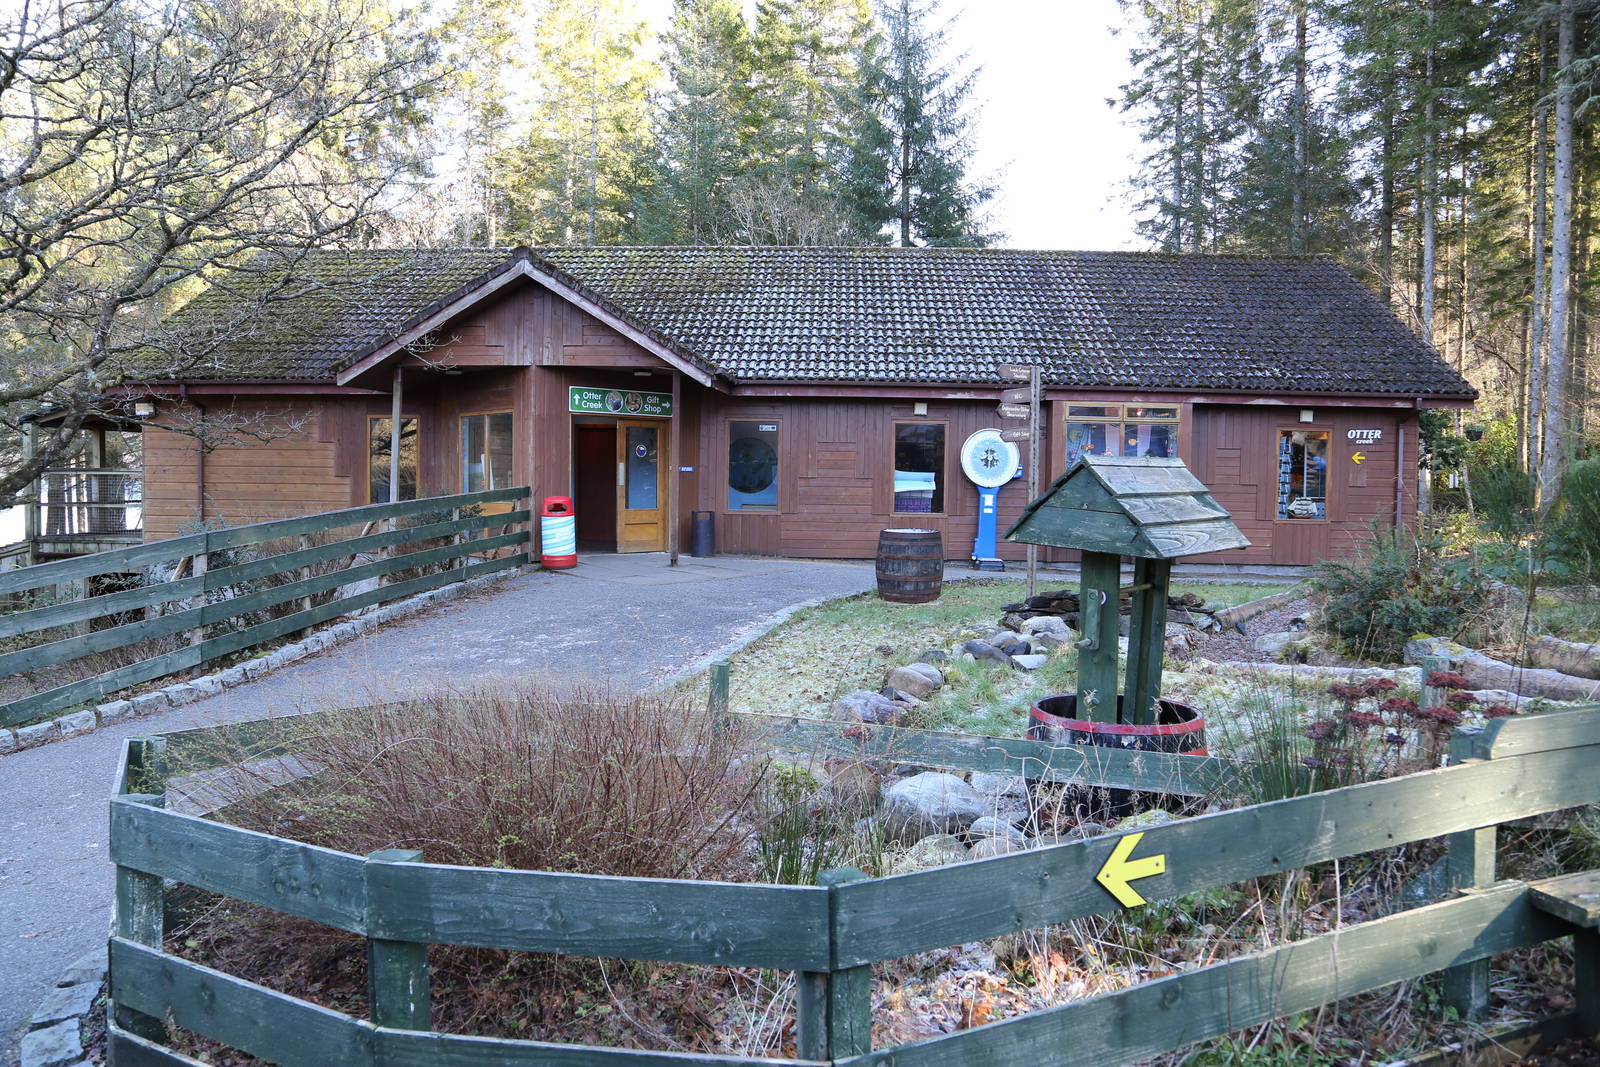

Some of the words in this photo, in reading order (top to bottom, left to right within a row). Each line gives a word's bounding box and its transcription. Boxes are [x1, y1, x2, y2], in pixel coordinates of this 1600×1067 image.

[582, 391, 602, 400] Otter
[646, 396, 660, 404] Gift
[581, 400, 603, 409] Creek
[644, 404, 662, 413] Shop
[1347, 429, 1382, 439] OTTER
